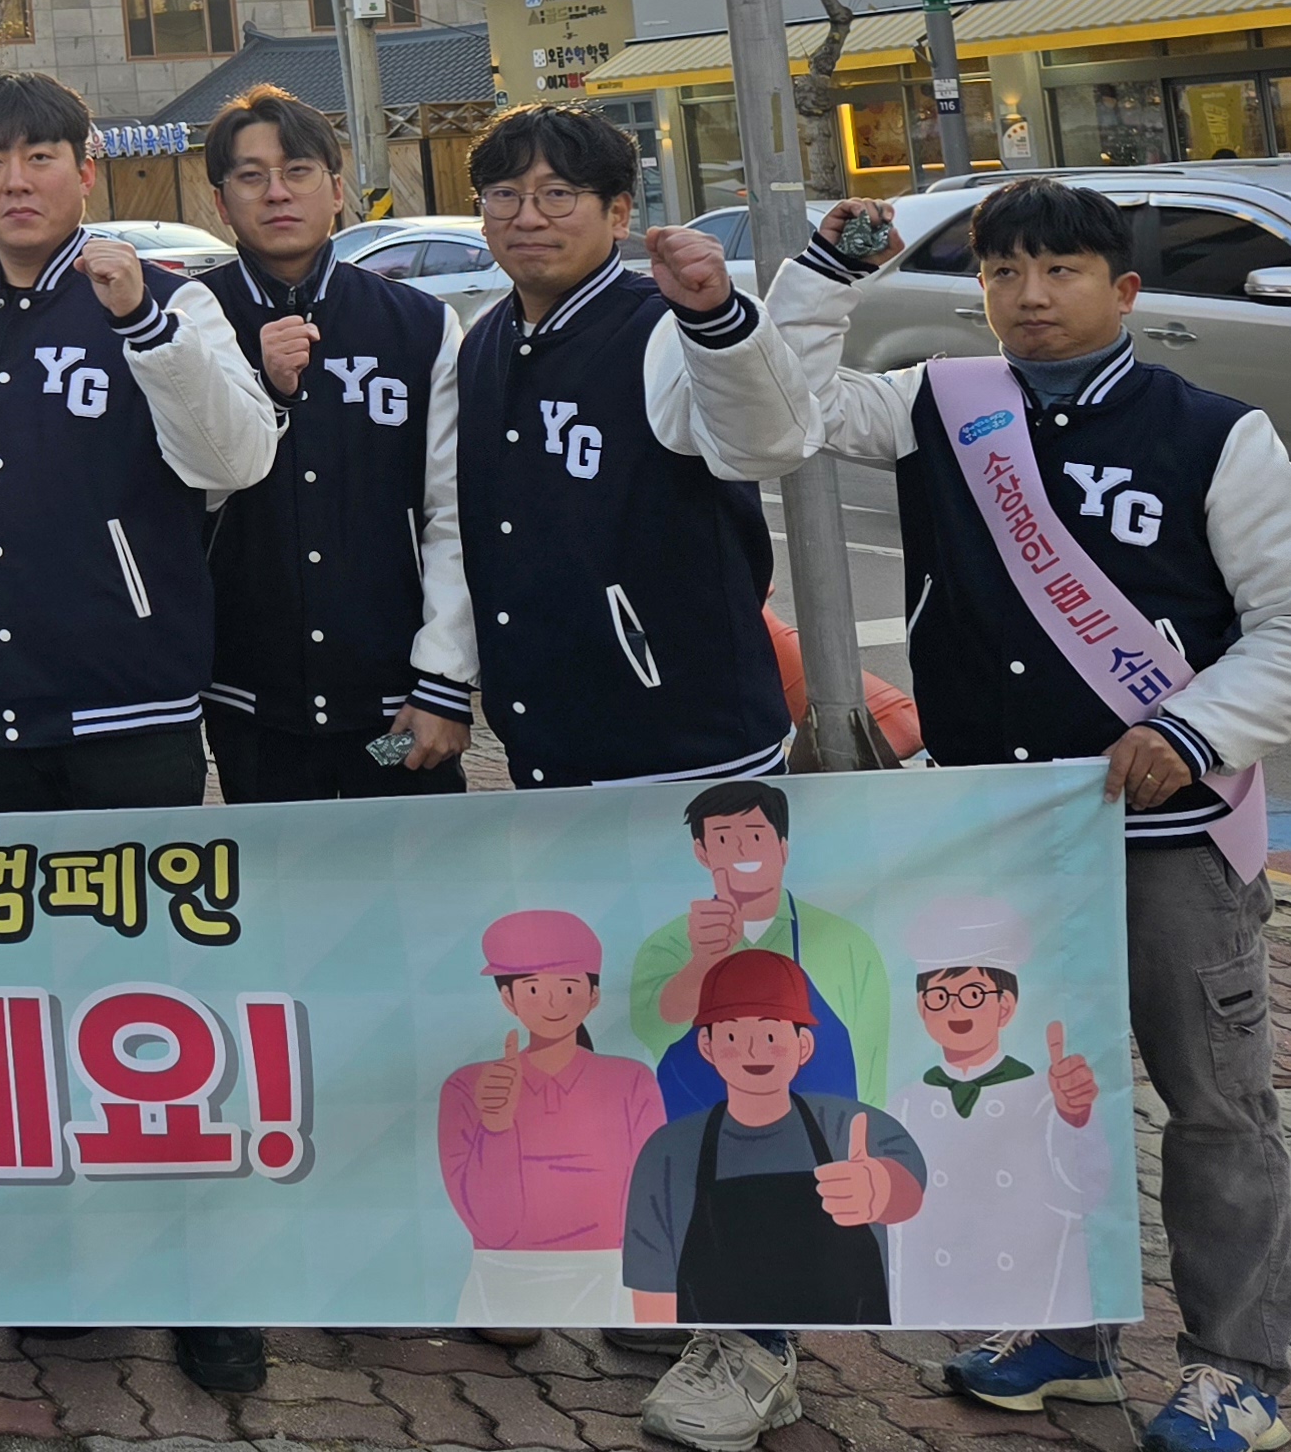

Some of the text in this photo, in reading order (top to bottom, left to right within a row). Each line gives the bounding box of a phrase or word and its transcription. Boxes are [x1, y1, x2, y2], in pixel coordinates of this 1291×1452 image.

[940, 101, 956, 111] 116
[983, 451, 1060, 574] 소상공인
[1044, 573, 1118, 645] 돕는
[1109, 646, 1172, 706] 소비
